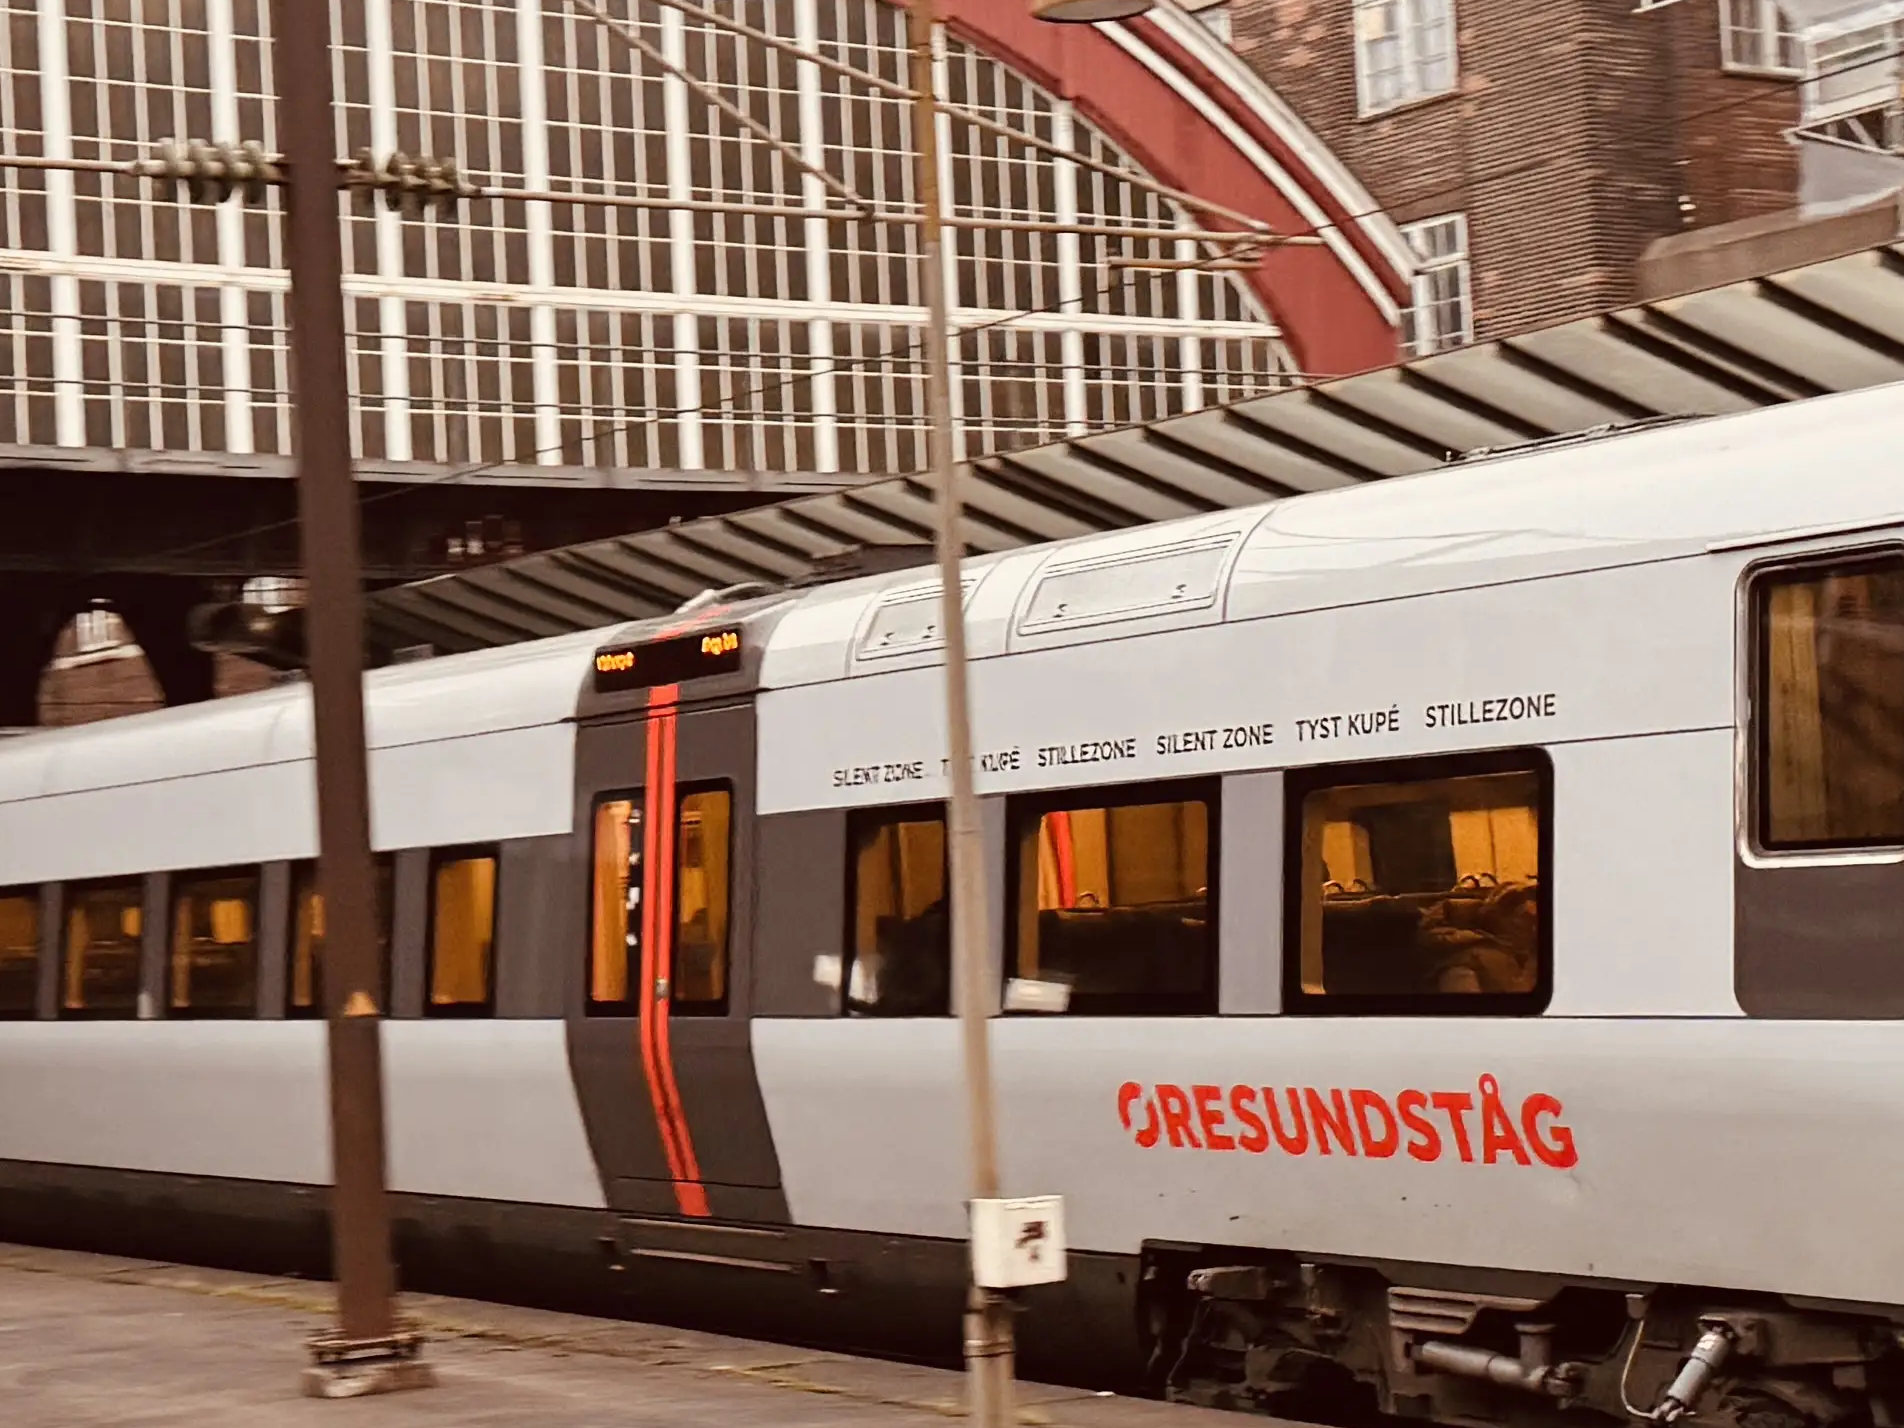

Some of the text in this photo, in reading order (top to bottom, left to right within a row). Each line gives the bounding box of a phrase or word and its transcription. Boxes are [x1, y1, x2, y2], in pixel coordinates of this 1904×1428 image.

[1037, 738, 1137, 767] STILLEZONE
[1156, 728, 1217, 755] SILENT
[1222, 723, 1273, 749] ZONE
[1296, 716, 1342, 742] TYST
[1348, 704, 1400, 735] KUPÉ
[1425, 693, 1557, 728] STILLEZONE
[1117, 1072, 1579, 1169] ØRESUNDSTÅG
